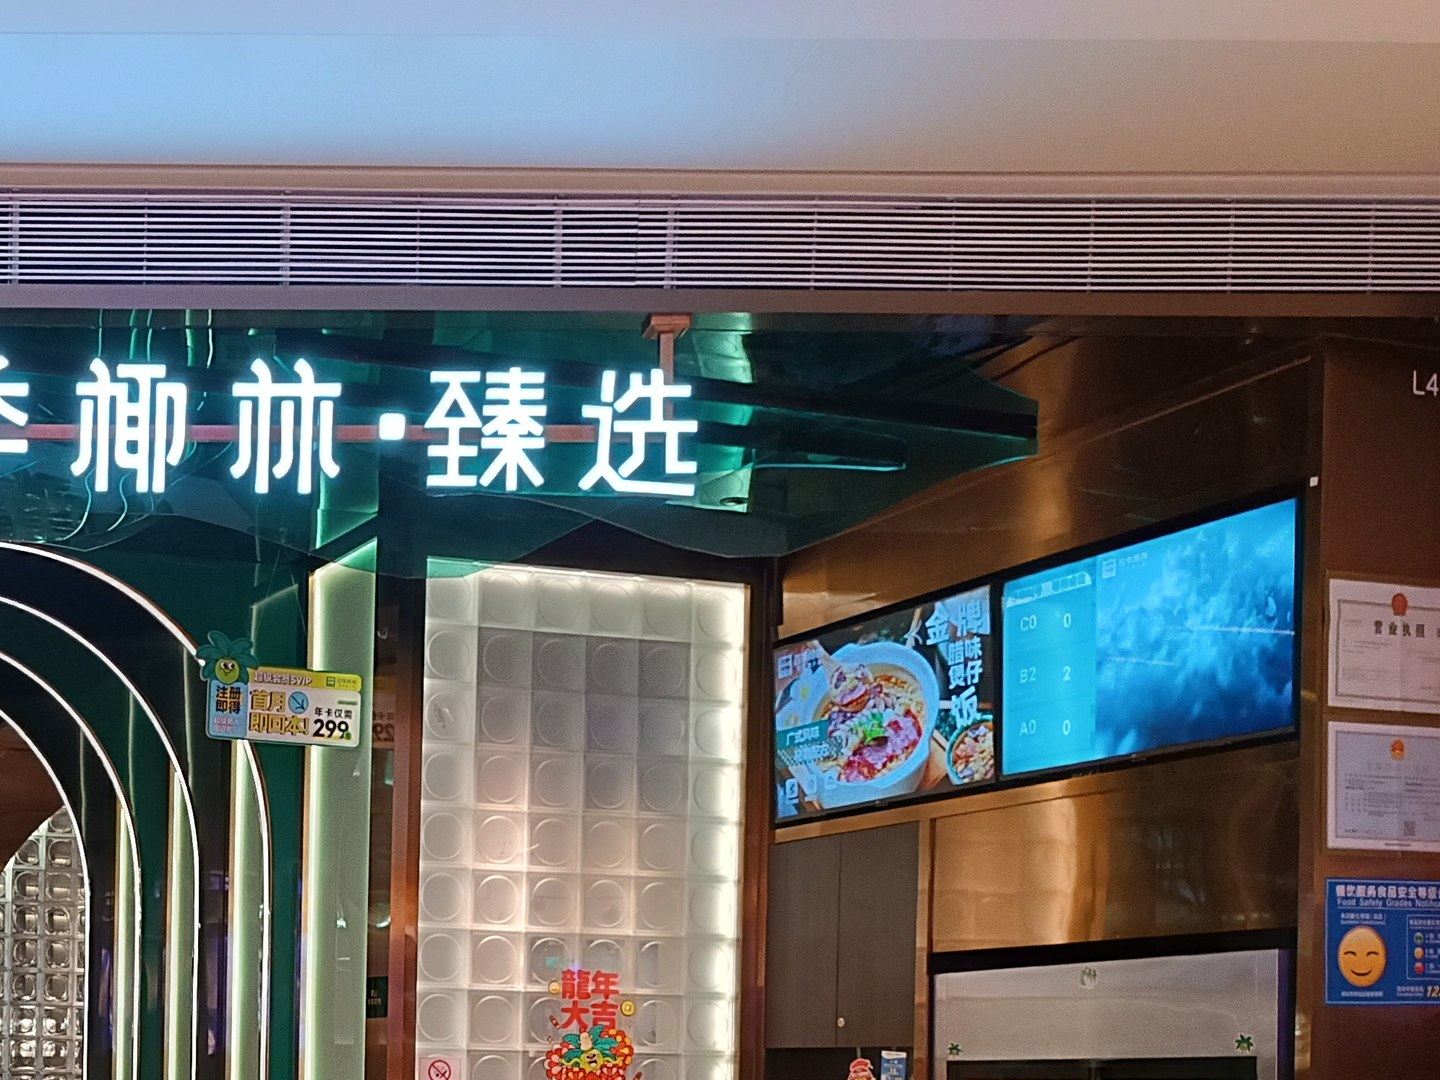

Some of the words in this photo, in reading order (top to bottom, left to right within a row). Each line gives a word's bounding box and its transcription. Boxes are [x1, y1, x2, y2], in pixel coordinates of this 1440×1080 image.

[925, 601, 982, 646] 金牌
[250, 689, 286, 711] 首月
[314, 706, 353, 720] 年卡仅需
[312, 719, 349, 739] 299
[1336, 884, 1440, 899] 餐饮服务食品安全等级
[561, 969, 620, 999] 龍年
[561, 1000, 619, 1031] 大吉
